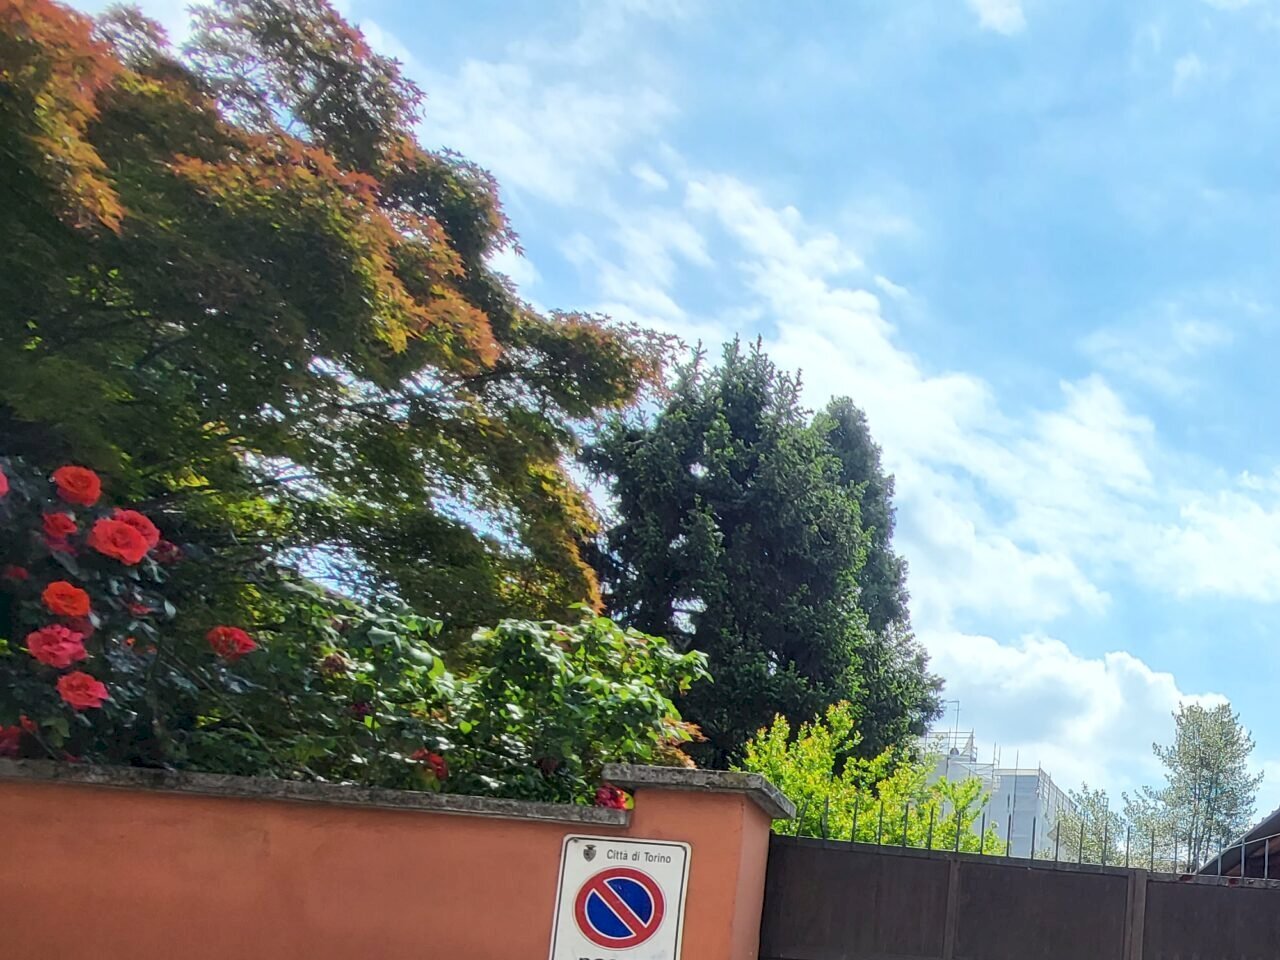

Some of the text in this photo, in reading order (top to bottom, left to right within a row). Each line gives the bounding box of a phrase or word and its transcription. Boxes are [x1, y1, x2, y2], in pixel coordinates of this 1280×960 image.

[606, 849, 671, 864] Città di Torino
